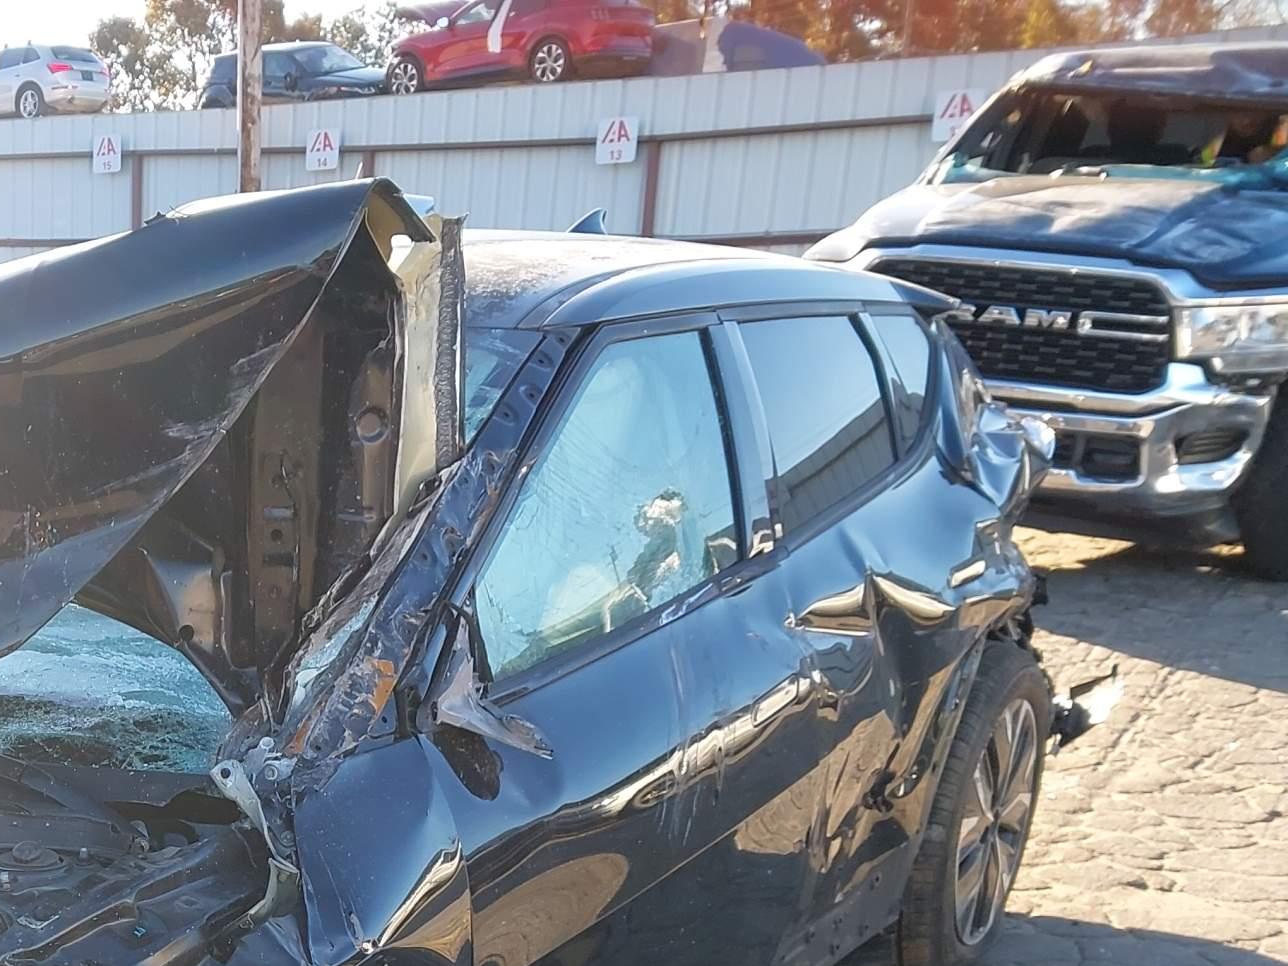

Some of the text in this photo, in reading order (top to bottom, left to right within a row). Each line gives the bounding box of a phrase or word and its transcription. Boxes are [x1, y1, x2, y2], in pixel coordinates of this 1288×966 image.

[609, 149, 622, 161] 13
[102, 160, 113, 170] 15
[316, 157, 328, 168] 14
